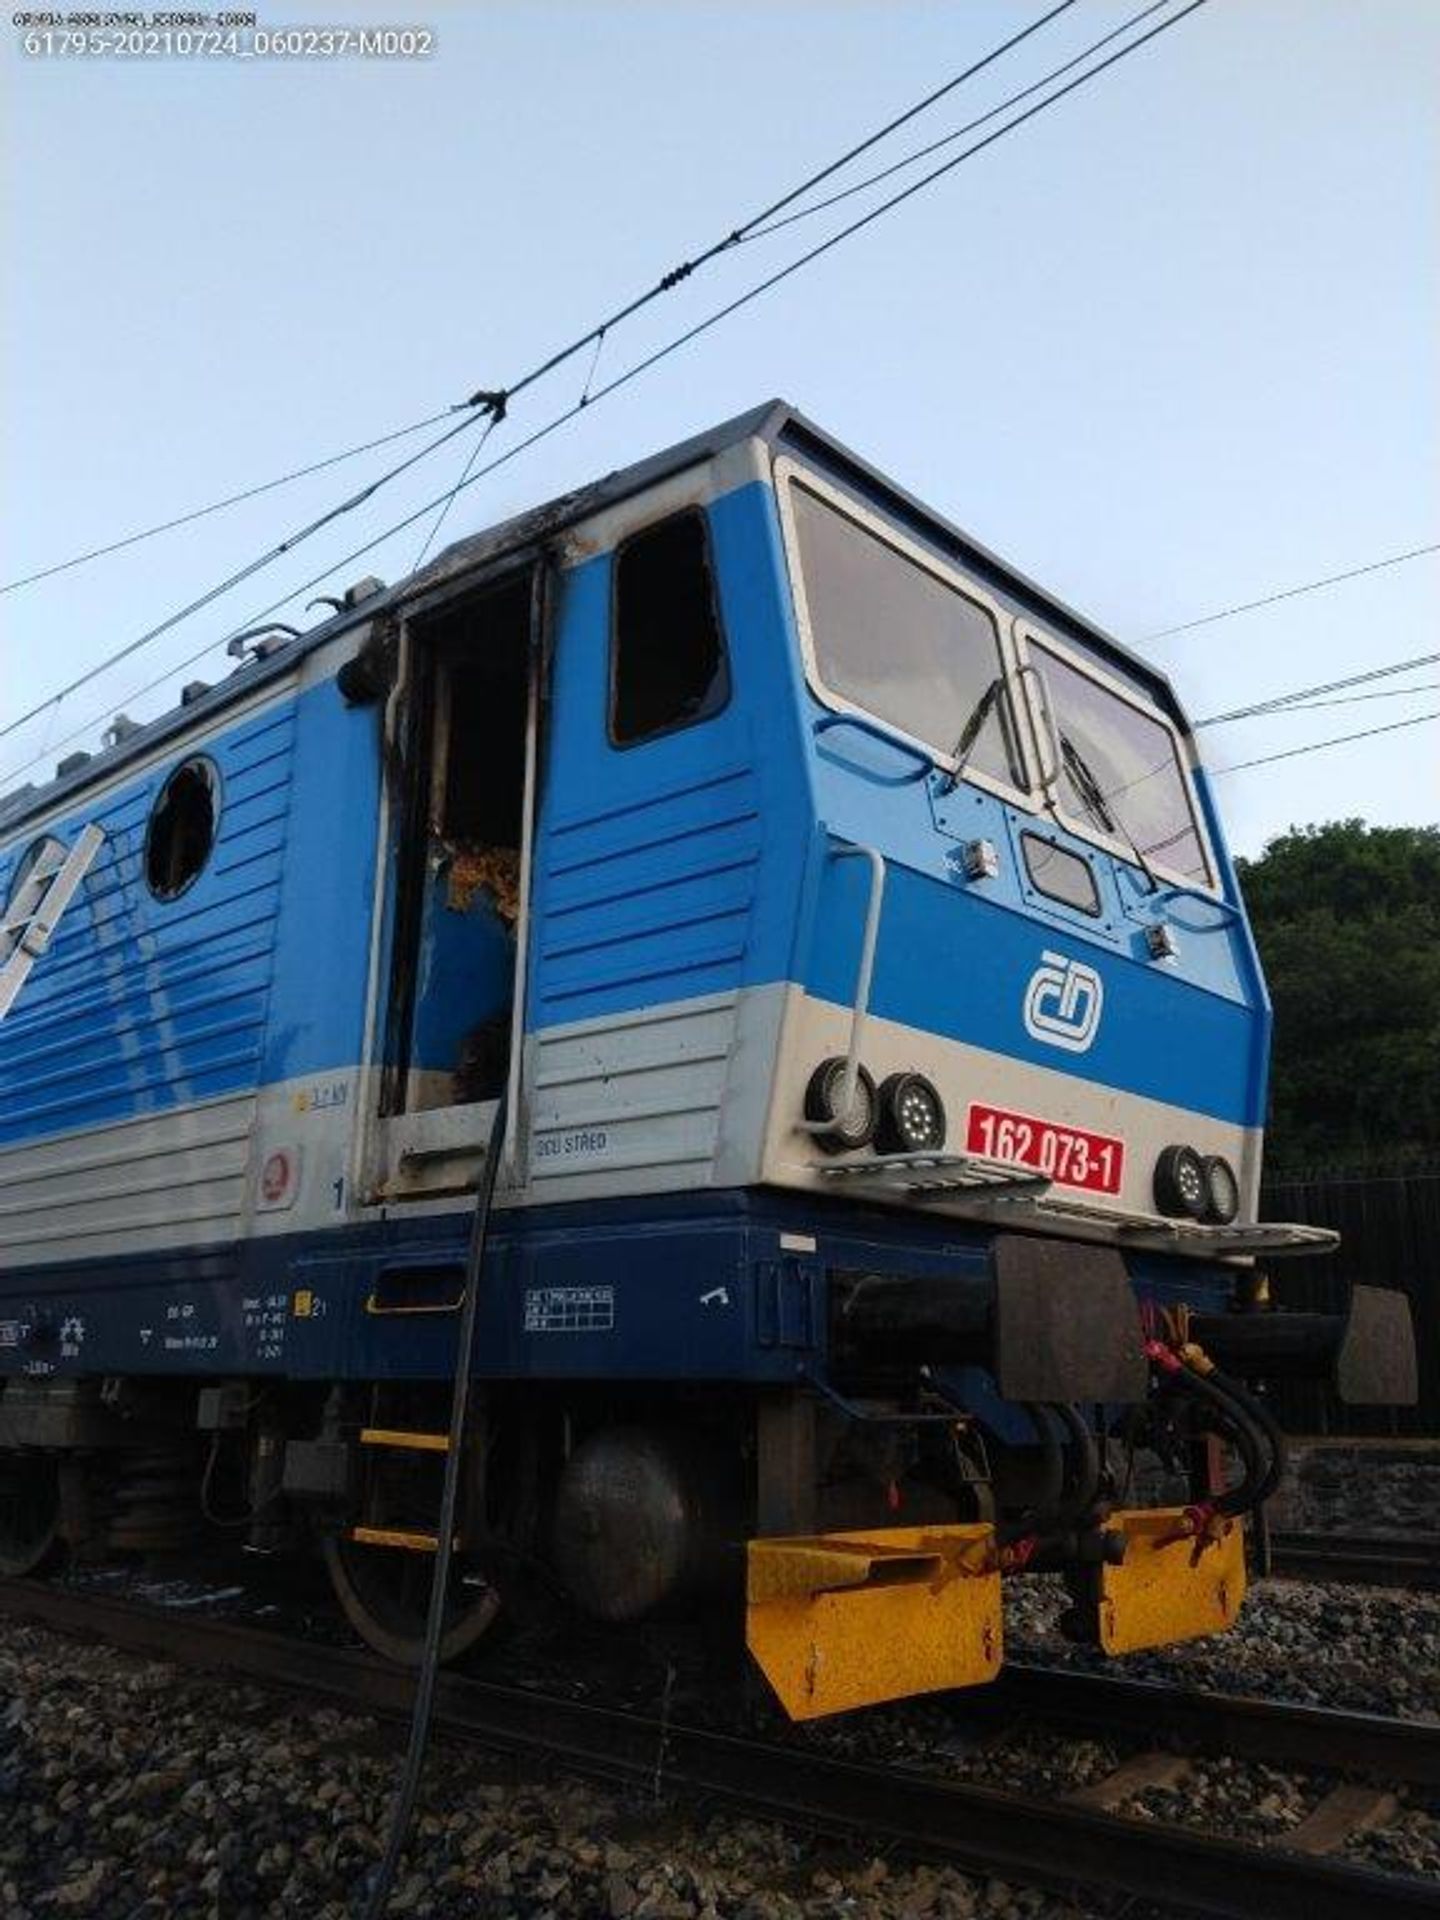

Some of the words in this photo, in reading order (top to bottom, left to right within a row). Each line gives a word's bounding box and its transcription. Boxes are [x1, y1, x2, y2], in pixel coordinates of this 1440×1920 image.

[979, 1114, 1033, 1164] 162
[1039, 1129, 1116, 1188] 073-1
[333, 1176, 344, 1210] 1
